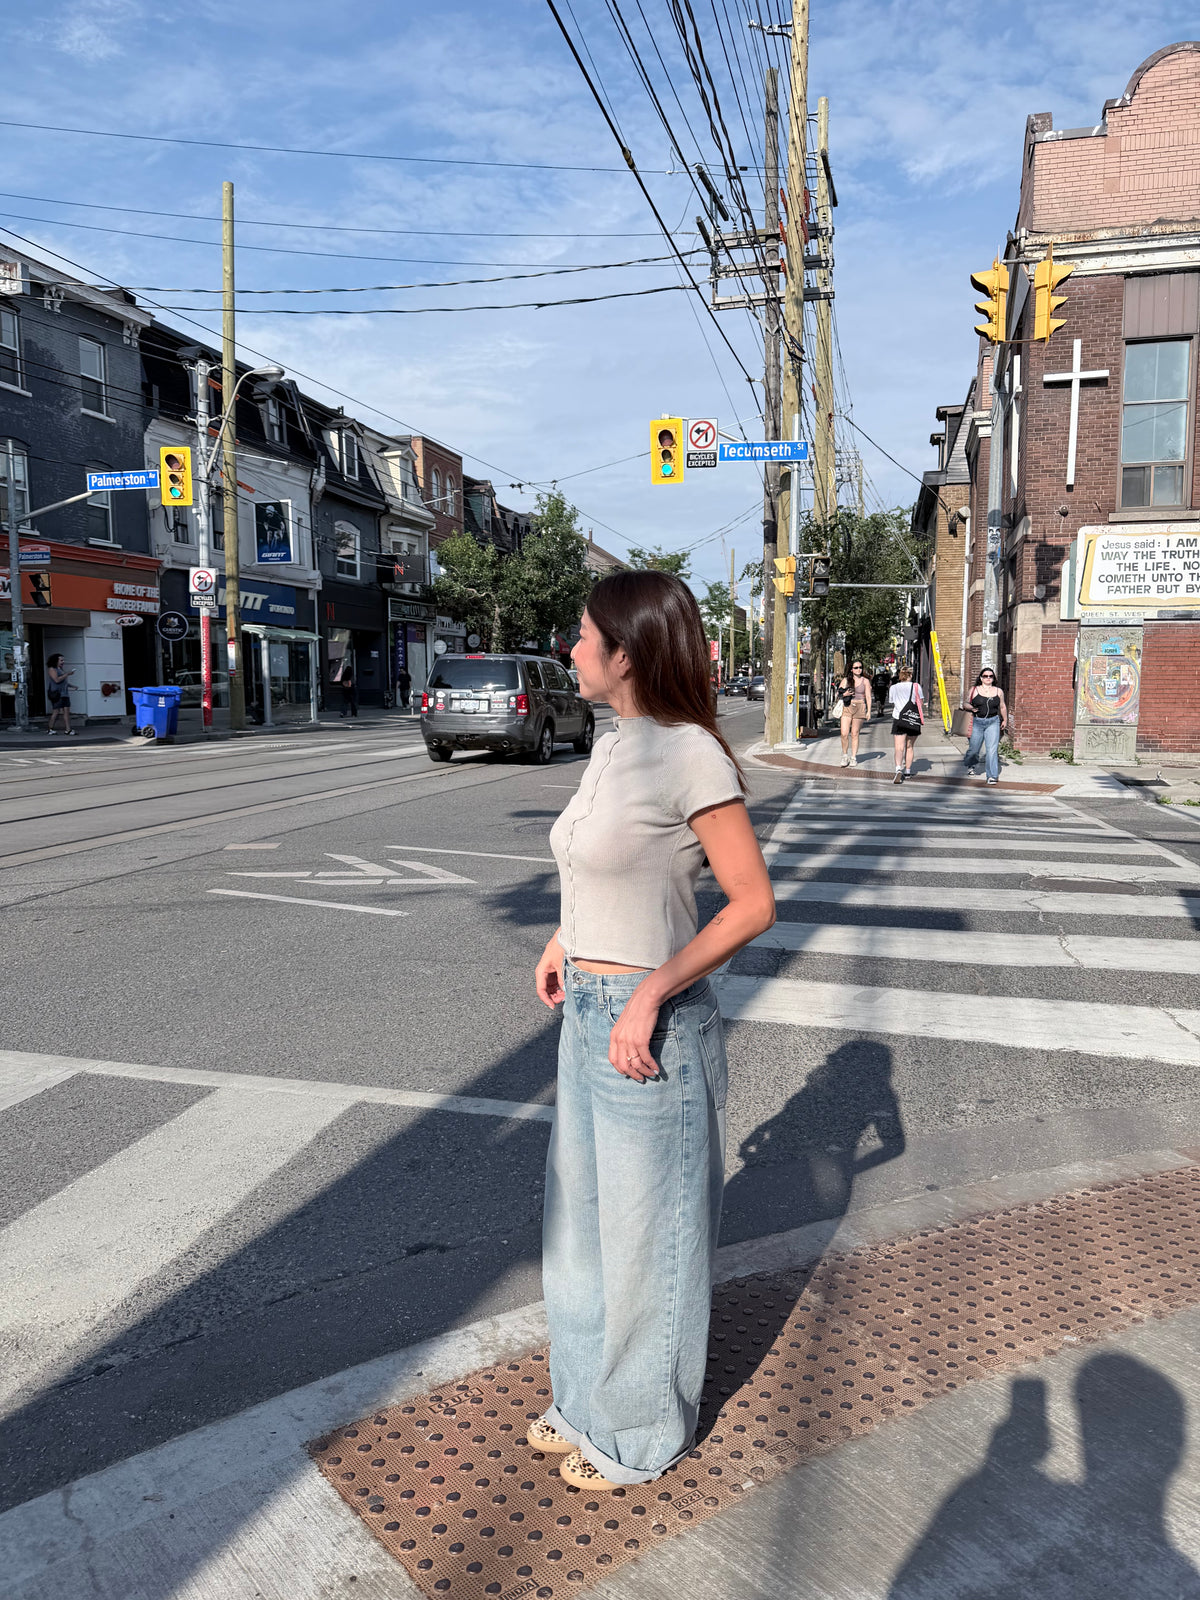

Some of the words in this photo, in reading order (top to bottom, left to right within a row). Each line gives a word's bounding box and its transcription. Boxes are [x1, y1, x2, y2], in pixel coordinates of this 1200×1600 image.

[723, 444, 791, 458] Tecumseth
[797, 443, 804, 451] St
[91, 474, 146, 487] Palmerston
[1102, 540, 1132, 549] Jesus
[1166, 539, 1170, 548] I
[1176, 538, 1198, 547] AM
[1101, 551, 1128, 560] WAY
[1133, 550, 1156, 559] THE
[1162, 549, 1200, 559] TRUTH
[1116, 562, 1139, 571] THE
[1183, 561, 1200, 570] NO
[1098, 574, 1146, 583] COMETH
[1151, 573, 1183, 582] UNTO
[114, 583, 136, 596] HOME
[147, 587, 160, 598] THE
[1107, 585, 1151, 594] FATHER
[1156, 584, 1180, 593] BUT
[1186, 584, 1200, 593] BY
[107, 598, 138, 611] BURGER
[675, 1491, 700, 1508] 2025
[502, 1582, 535, 1600] INDIA
